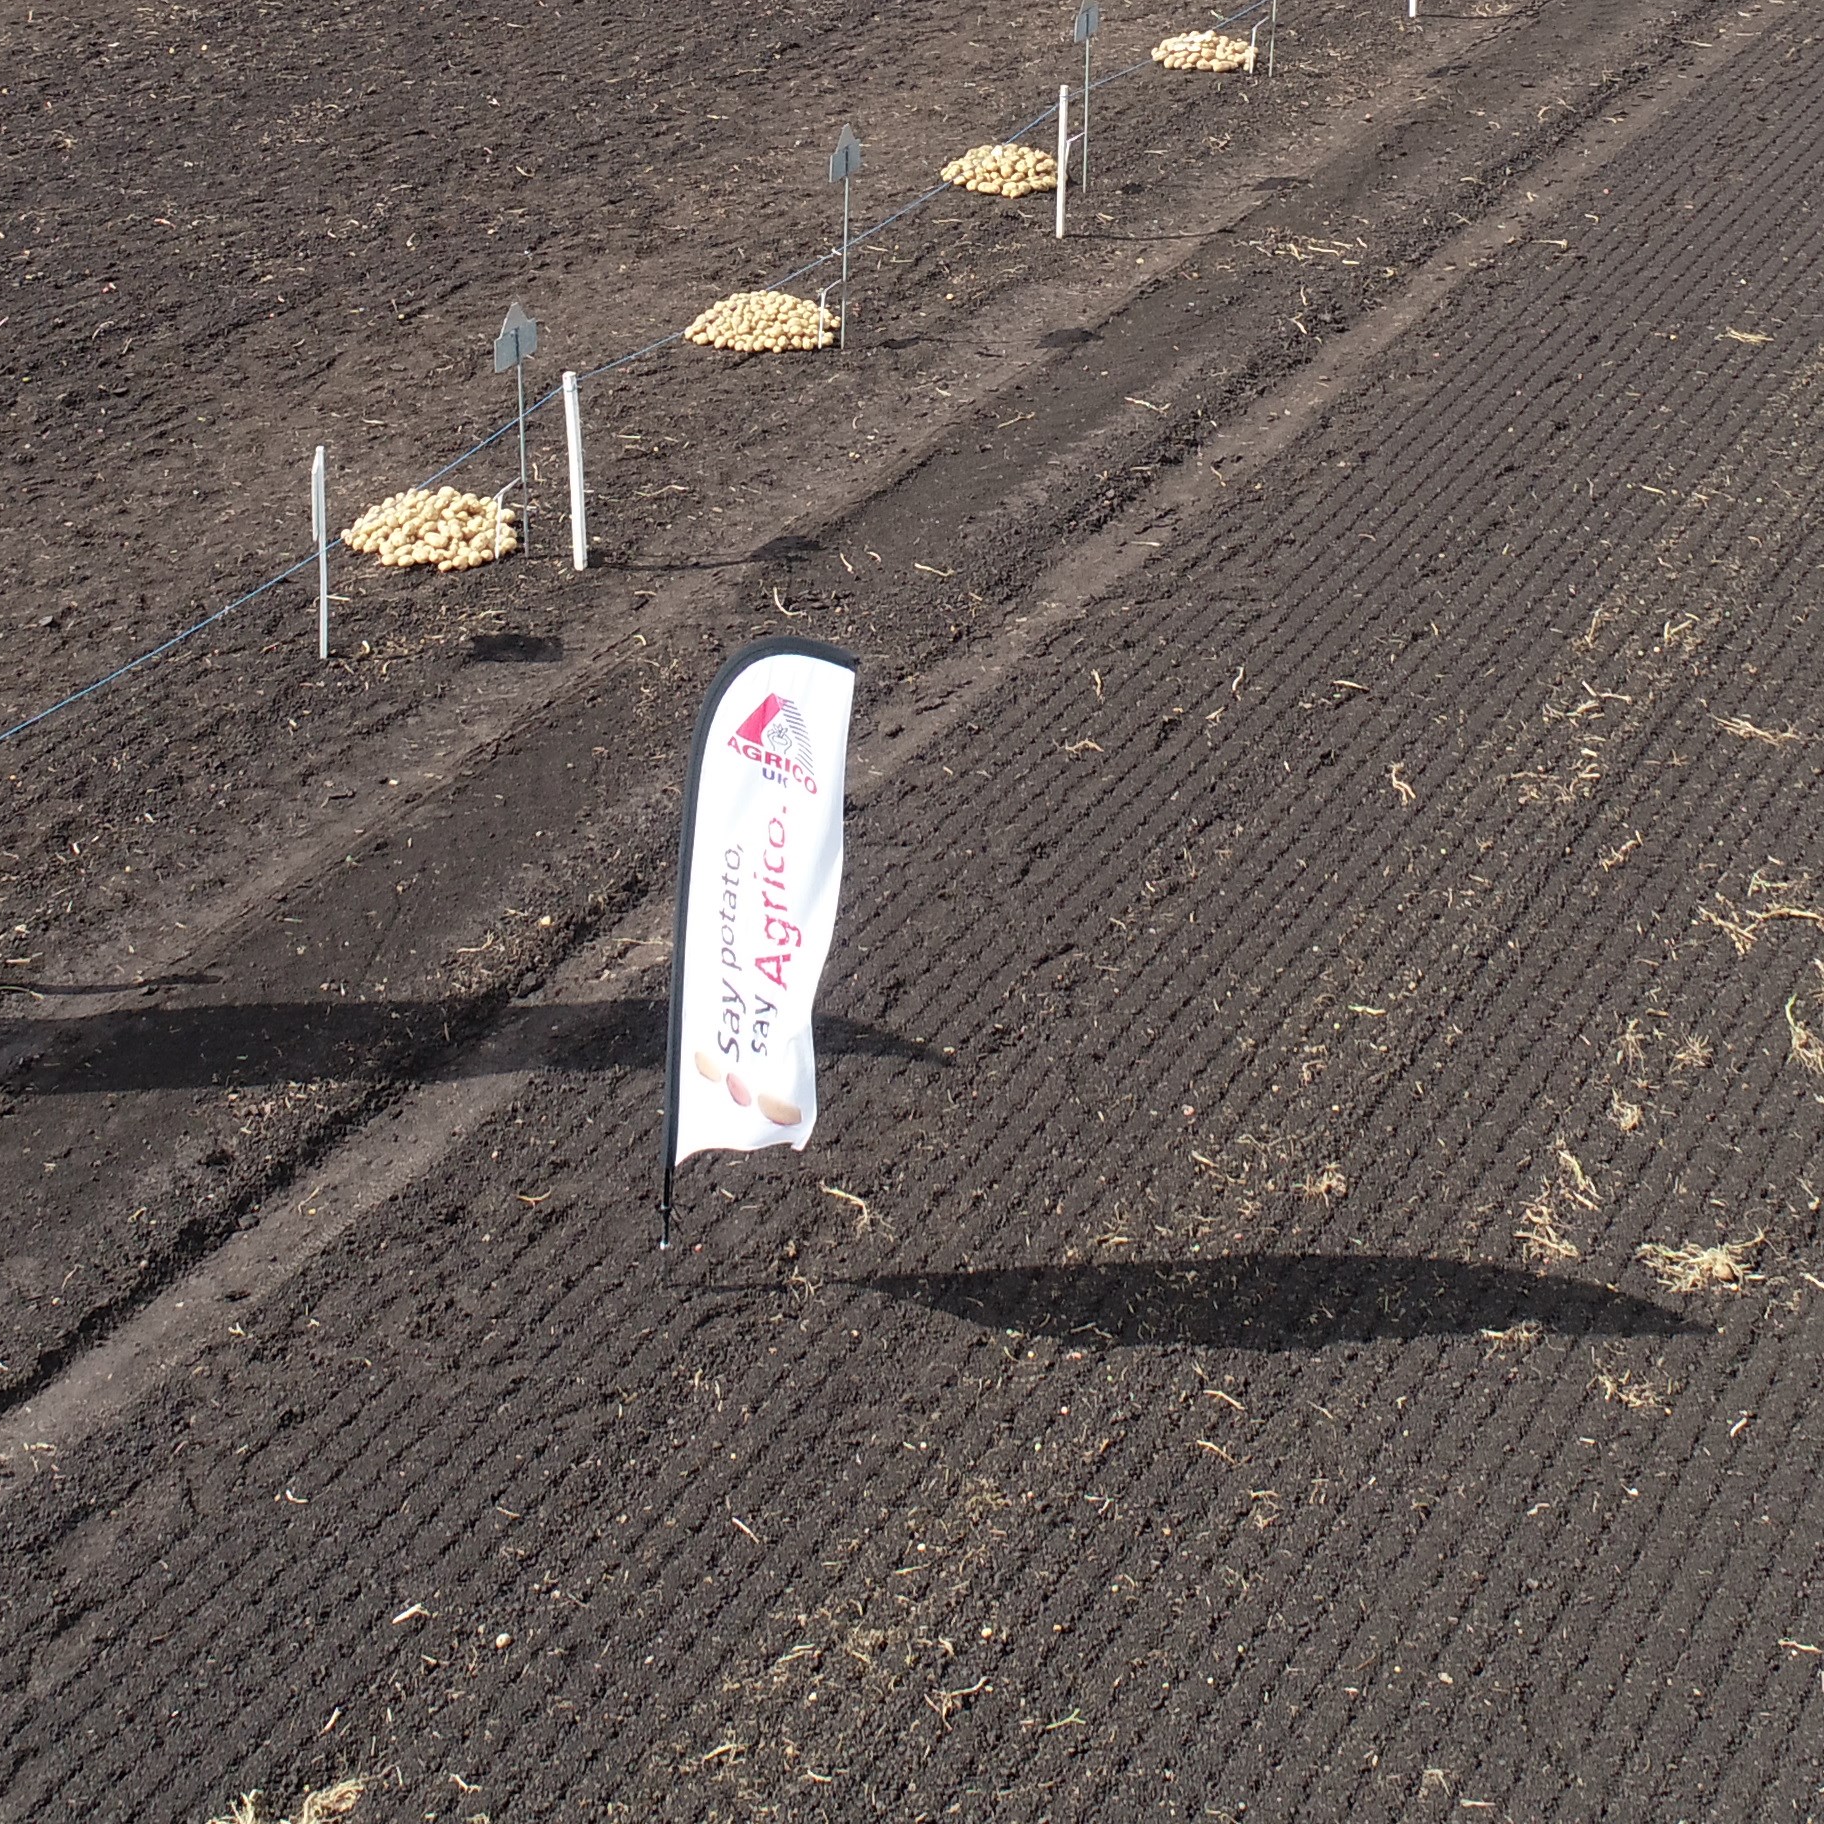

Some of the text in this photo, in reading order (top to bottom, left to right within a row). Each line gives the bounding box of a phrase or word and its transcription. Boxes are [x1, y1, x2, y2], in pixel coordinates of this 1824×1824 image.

[727, 735, 818, 795] AGRICO
[762, 767, 789, 789] UK
[717, 843, 746, 1063] Say potato,
[751, 805, 802, 1057] say Agrico.
